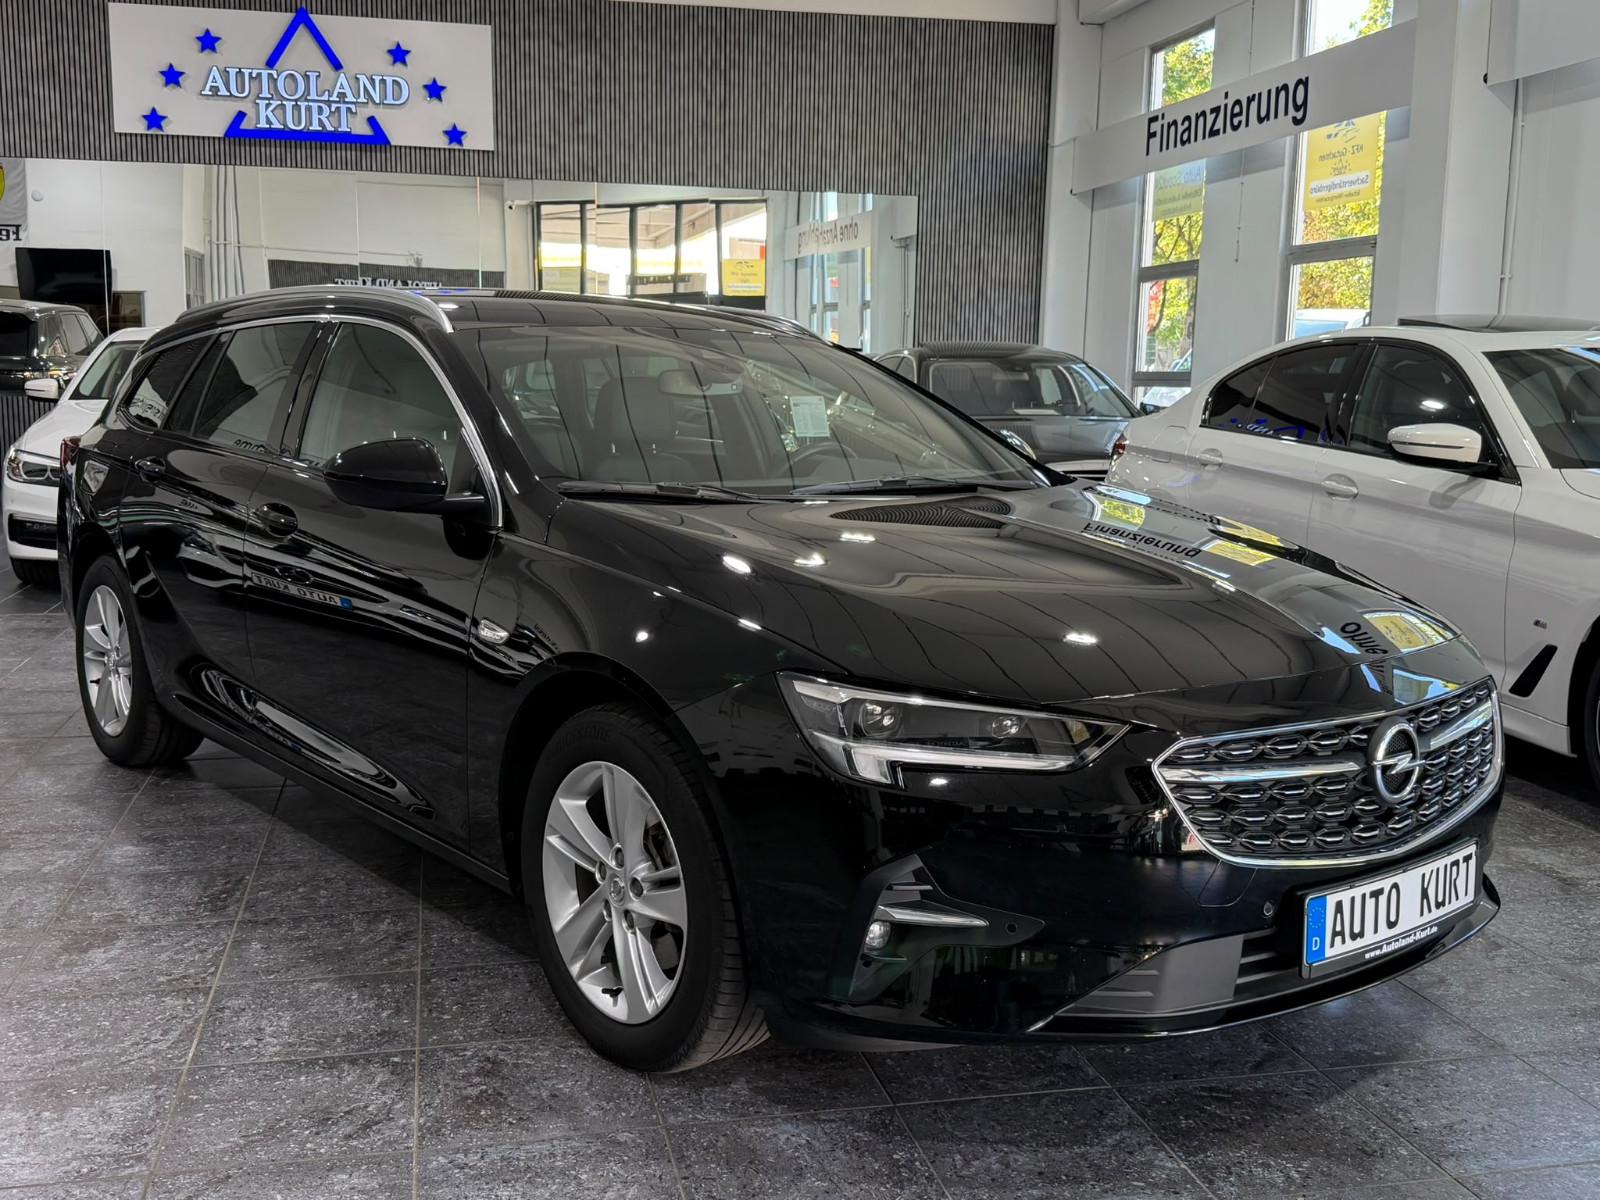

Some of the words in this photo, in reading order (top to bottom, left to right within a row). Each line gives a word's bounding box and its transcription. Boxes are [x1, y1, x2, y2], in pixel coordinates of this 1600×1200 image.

[201, 65, 410, 105] AUTOLAND
[255, 99, 357, 132] KURT
[1146, 76, 1309, 156] Finanzierung
[1329, 881, 1401, 949] AUTO
[1419, 852, 1473, 917] KURT
[1312, 936, 1321, 951] D
[1364, 925, 1438, 959] www.Autoland-Kurt.de
